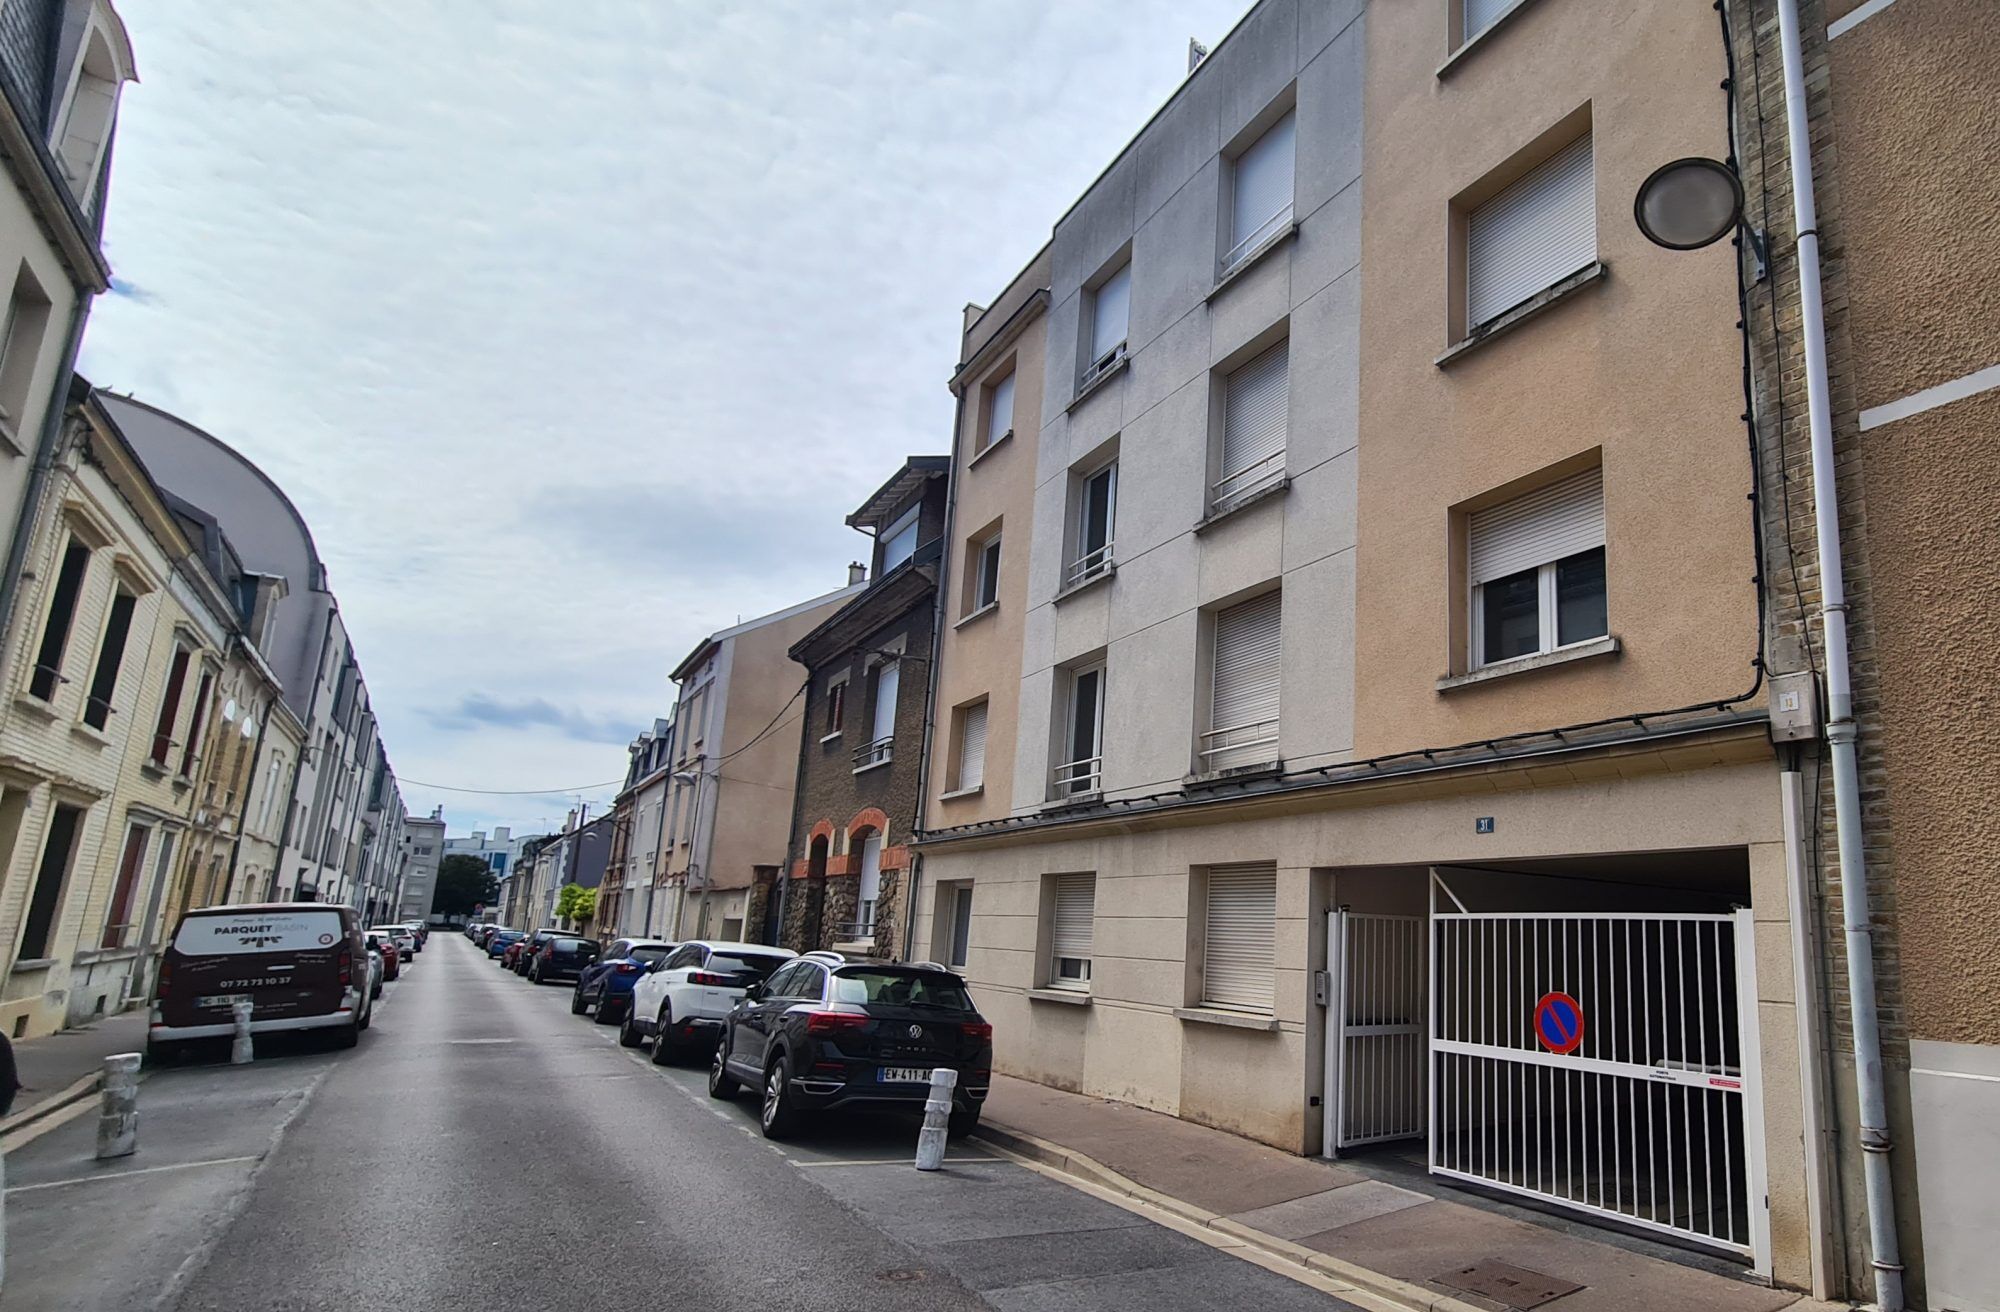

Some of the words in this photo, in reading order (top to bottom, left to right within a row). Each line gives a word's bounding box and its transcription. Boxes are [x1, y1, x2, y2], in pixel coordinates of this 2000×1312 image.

[1480, 819, 1488, 830] 31
[214, 925, 272, 935] PARQUET
[220, 980, 234, 988] 07
[236, 979, 249, 987] 72
[251, 978, 263, 986] 72
[265, 977, 277, 985] 10
[278, 976, 291, 984] 37
